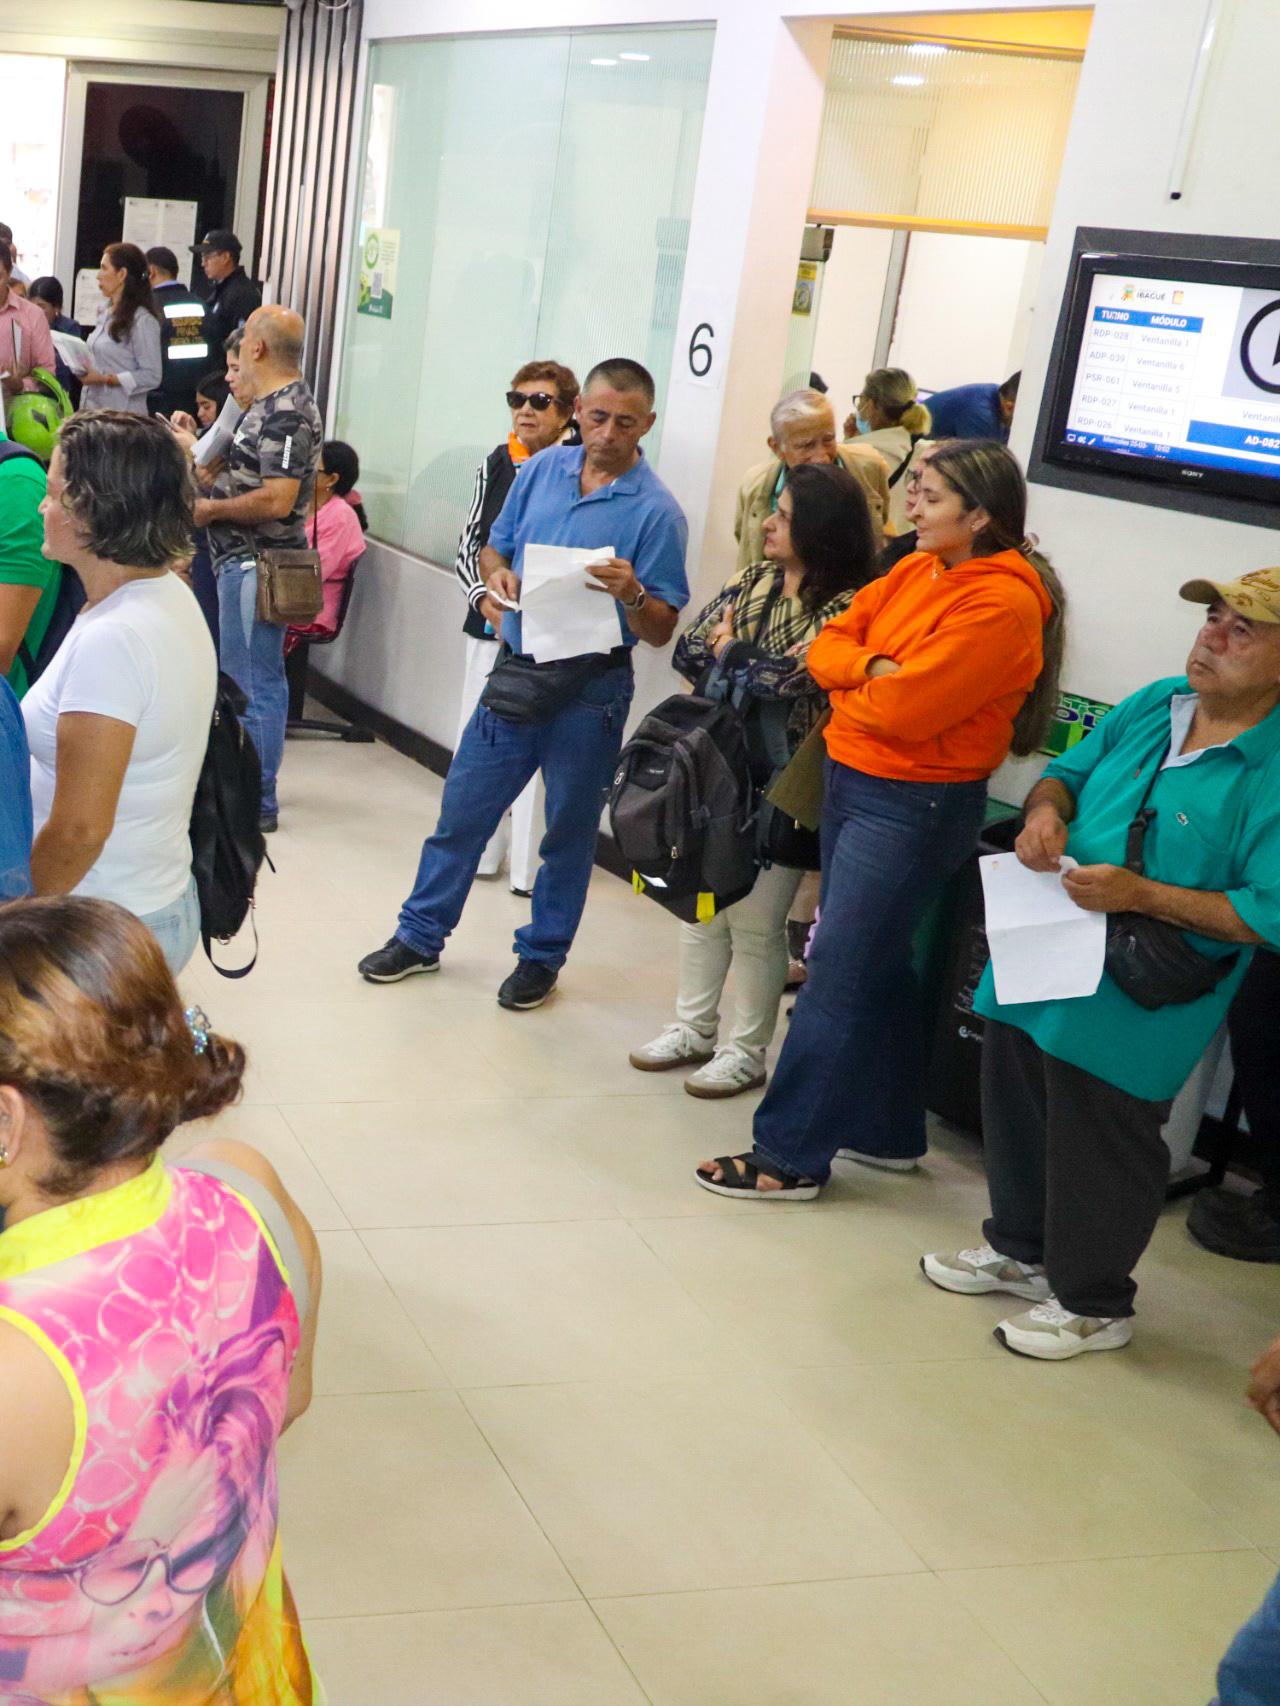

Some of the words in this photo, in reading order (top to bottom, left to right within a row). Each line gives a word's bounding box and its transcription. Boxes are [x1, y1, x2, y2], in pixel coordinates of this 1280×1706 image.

[1101, 309, 1130, 321] TURNO
[1150, 313, 1188, 328] MÓDULO
[1141, 335, 1182, 347] Ventanilla
[689, 323, 714, 377] 6
[1137, 357, 1178, 370] Ventanilla
[1132, 379, 1172, 393] Ventanilla
[1128, 402, 1168, 415] Ventanilla
[1242, 410, 1280, 424] Ventanill
[1124, 423, 1163, 437] Ventanilla
[1181, 469, 1204, 479] SONY
